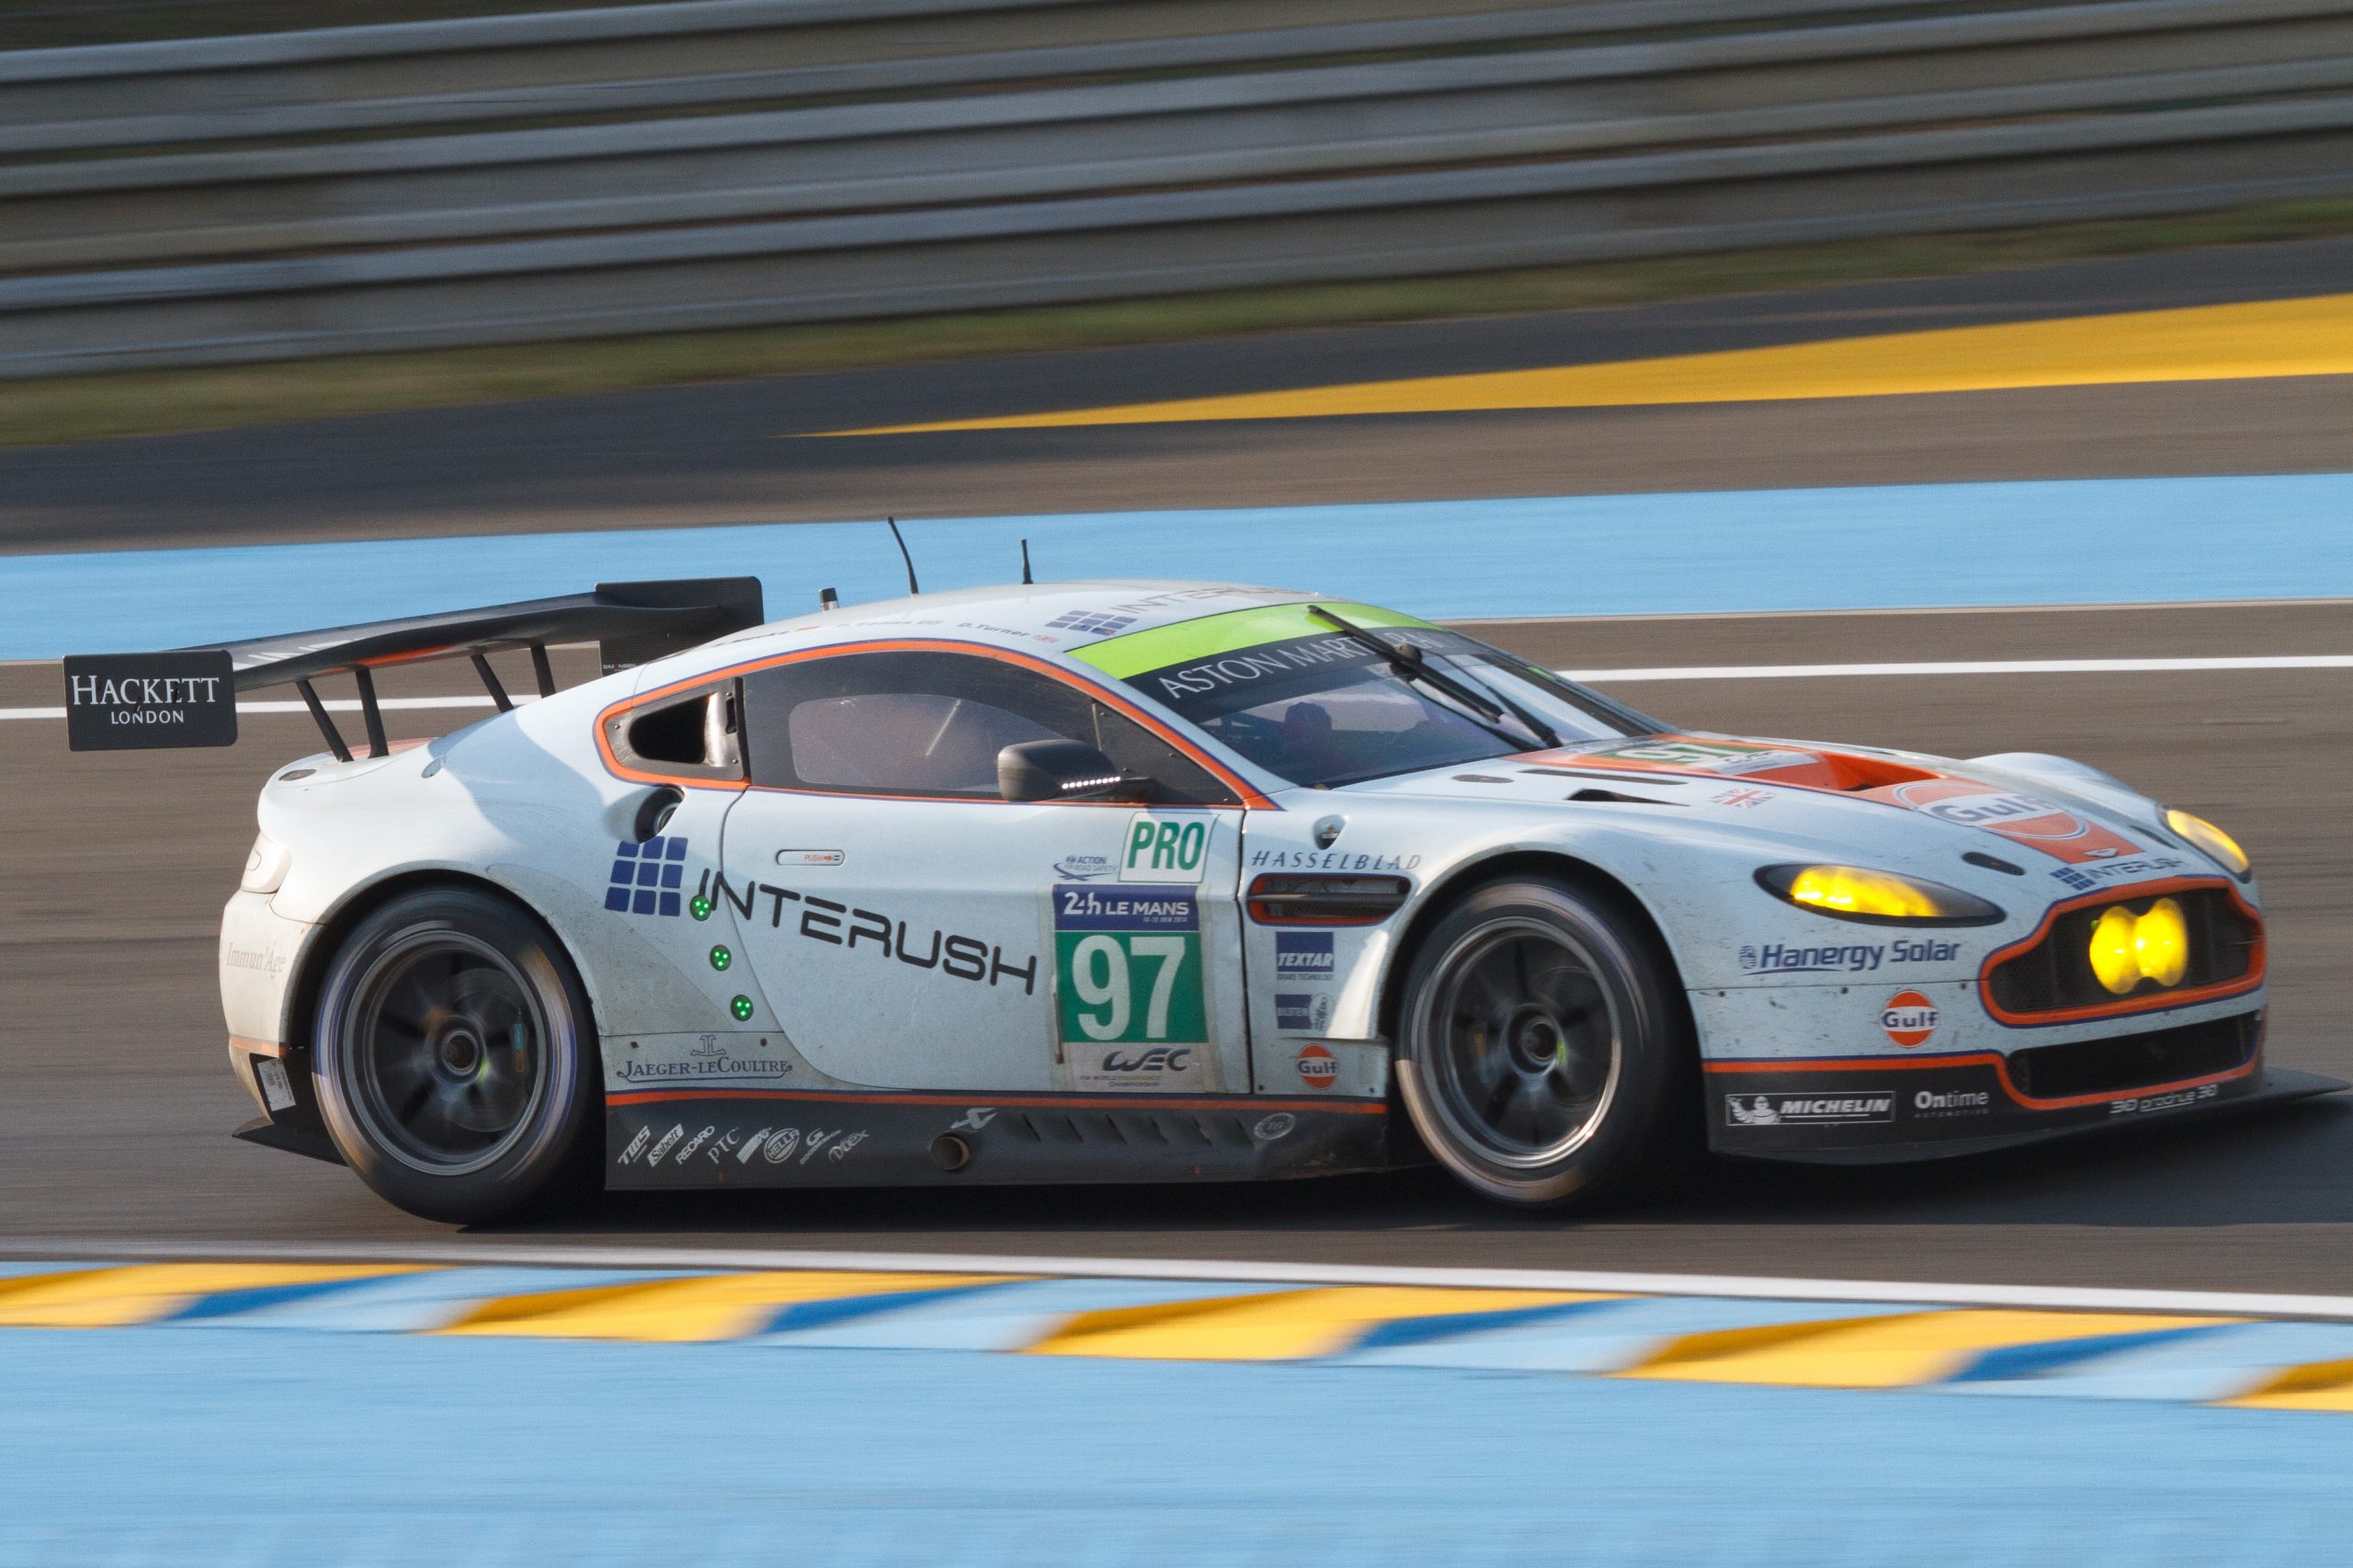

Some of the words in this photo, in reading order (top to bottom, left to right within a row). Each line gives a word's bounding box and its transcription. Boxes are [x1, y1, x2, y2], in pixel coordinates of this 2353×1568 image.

[1158, 653, 1291, 699] ASTON
[1278, 636, 1378, 667] MARTI
[71, 675, 220, 706] HACKETT
[110, 710, 184, 724] LONDON
[1127, 822, 1205, 870] PRO
[1077, 857, 1107, 865] ACTION
[1252, 850, 1421, 870] HASSELBLAD
[1063, 892, 1102, 915] 24h
[1106, 902, 1130, 915] LE
[1132, 902, 1189, 915] MANS
[699, 868, 1037, 995] INTERUSH
[1279, 952, 1333, 966] TEXTAR
[1761, 945, 1885, 971] Hanergy
[1890, 939, 1961, 962] Solar
[1072, 935, 1186, 1040] 97
[1882, 1012, 1937, 1028] Gulf
[1103, 1048, 1191, 1072] WEC
[1298, 1060, 1336, 1074] Gulf
[1779, 1099, 1891, 1113] MICHELIN
[1914, 1091, 1989, 1109] Ontime
[676, 1126, 715, 1165] RECARO
[767, 1129, 800, 1156] HELLA
